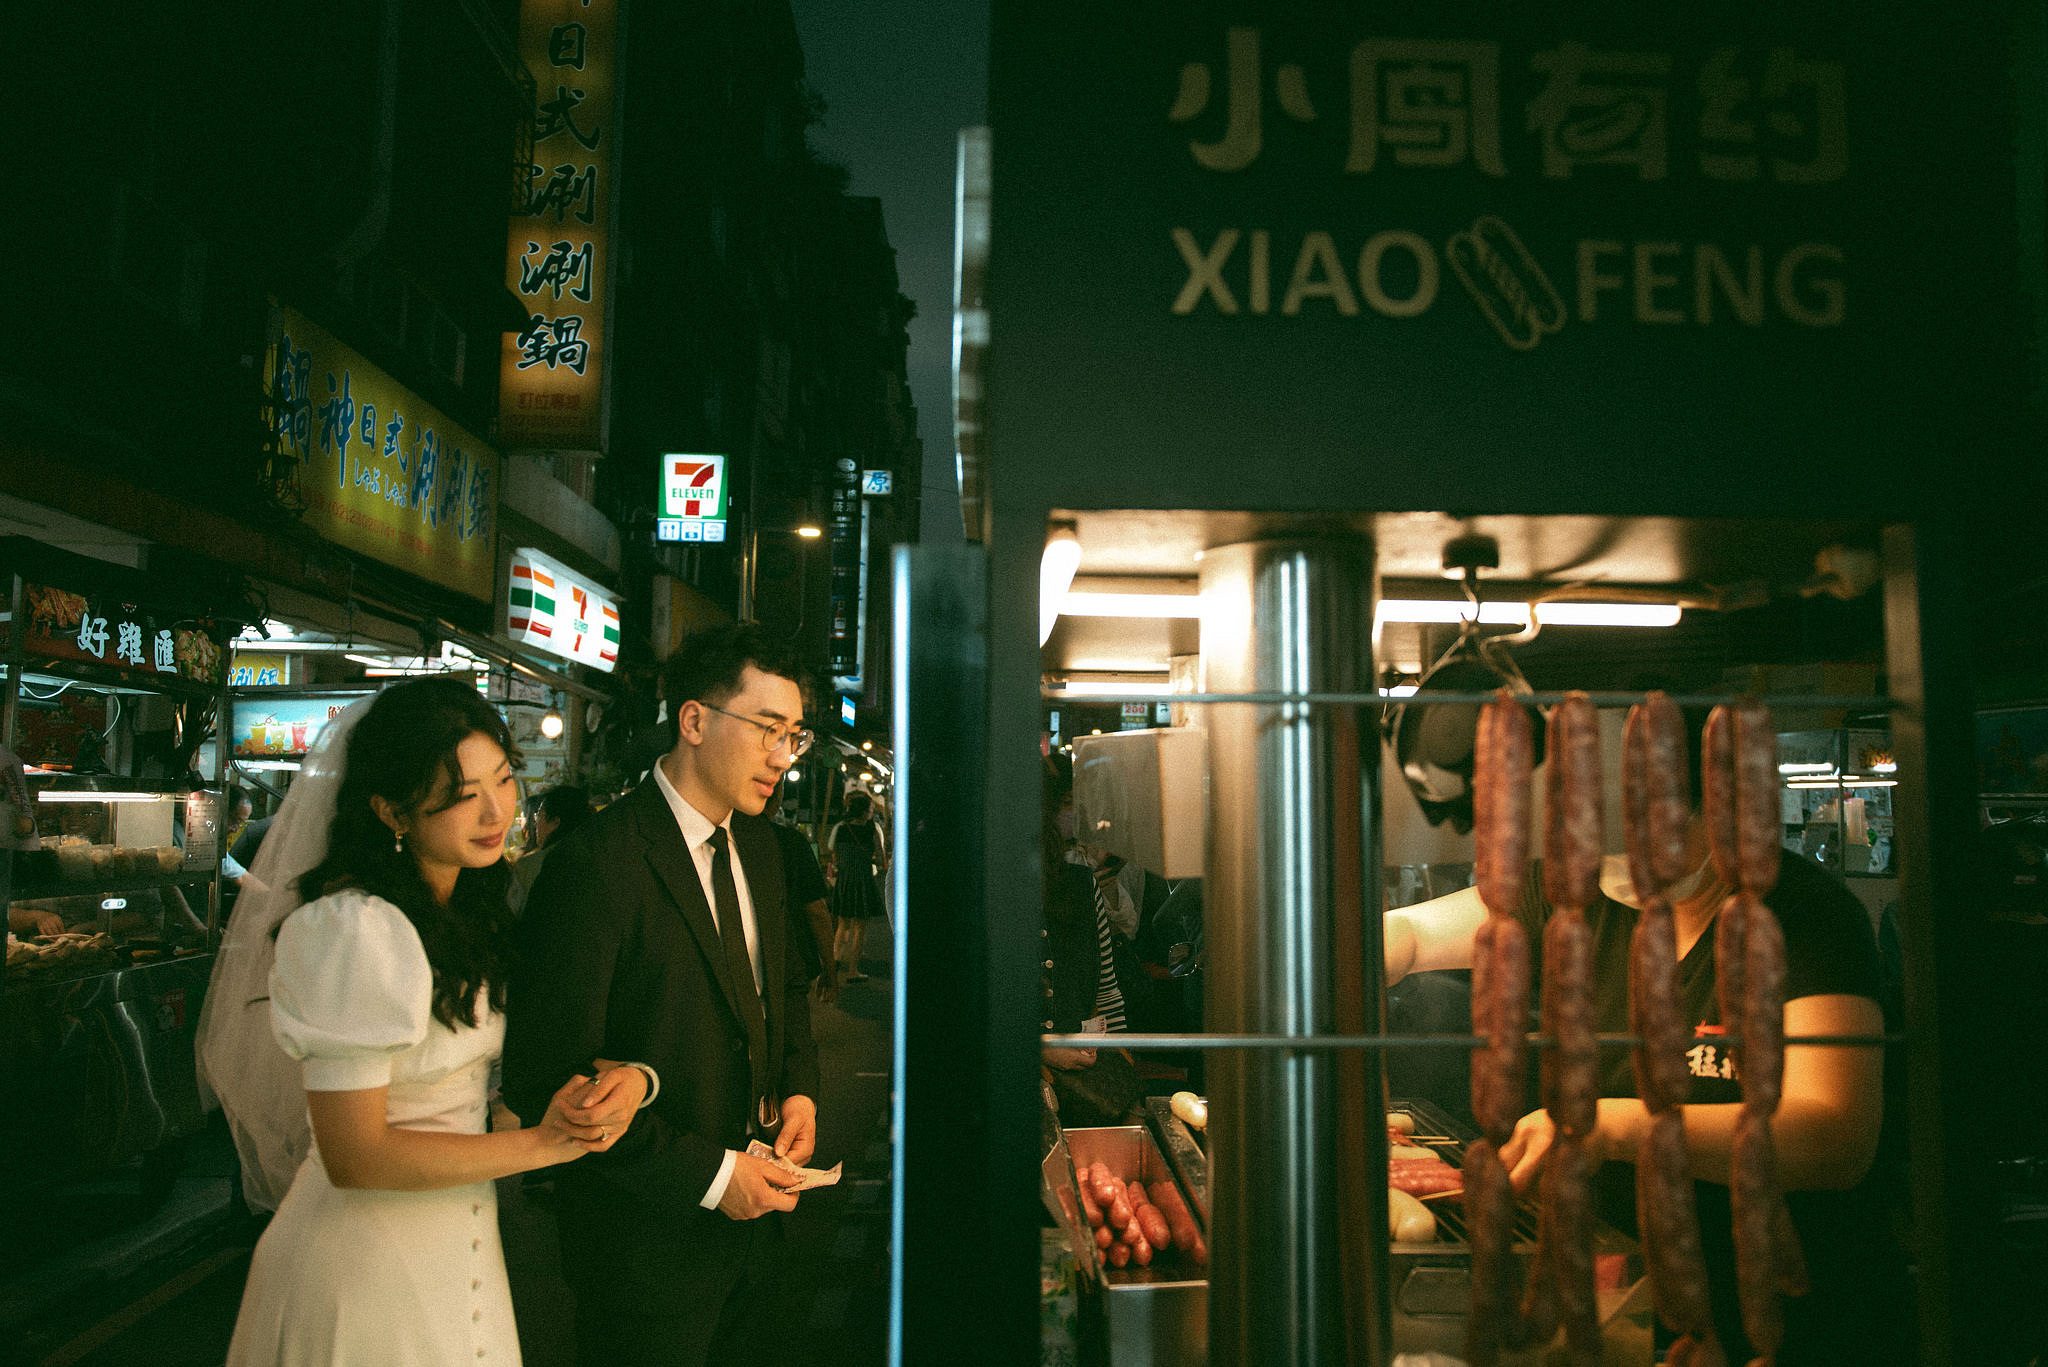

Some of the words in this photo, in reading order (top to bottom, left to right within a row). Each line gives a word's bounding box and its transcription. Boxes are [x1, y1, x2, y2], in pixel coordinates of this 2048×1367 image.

[517, 0, 600, 377] 日式涮涮鍋
[1170, 226, 1441, 318] XIAO
[1576, 240, 1847, 327] FENG
[867, 472, 889, 492] 原
[77, 612, 178, 674] 好雞匯
